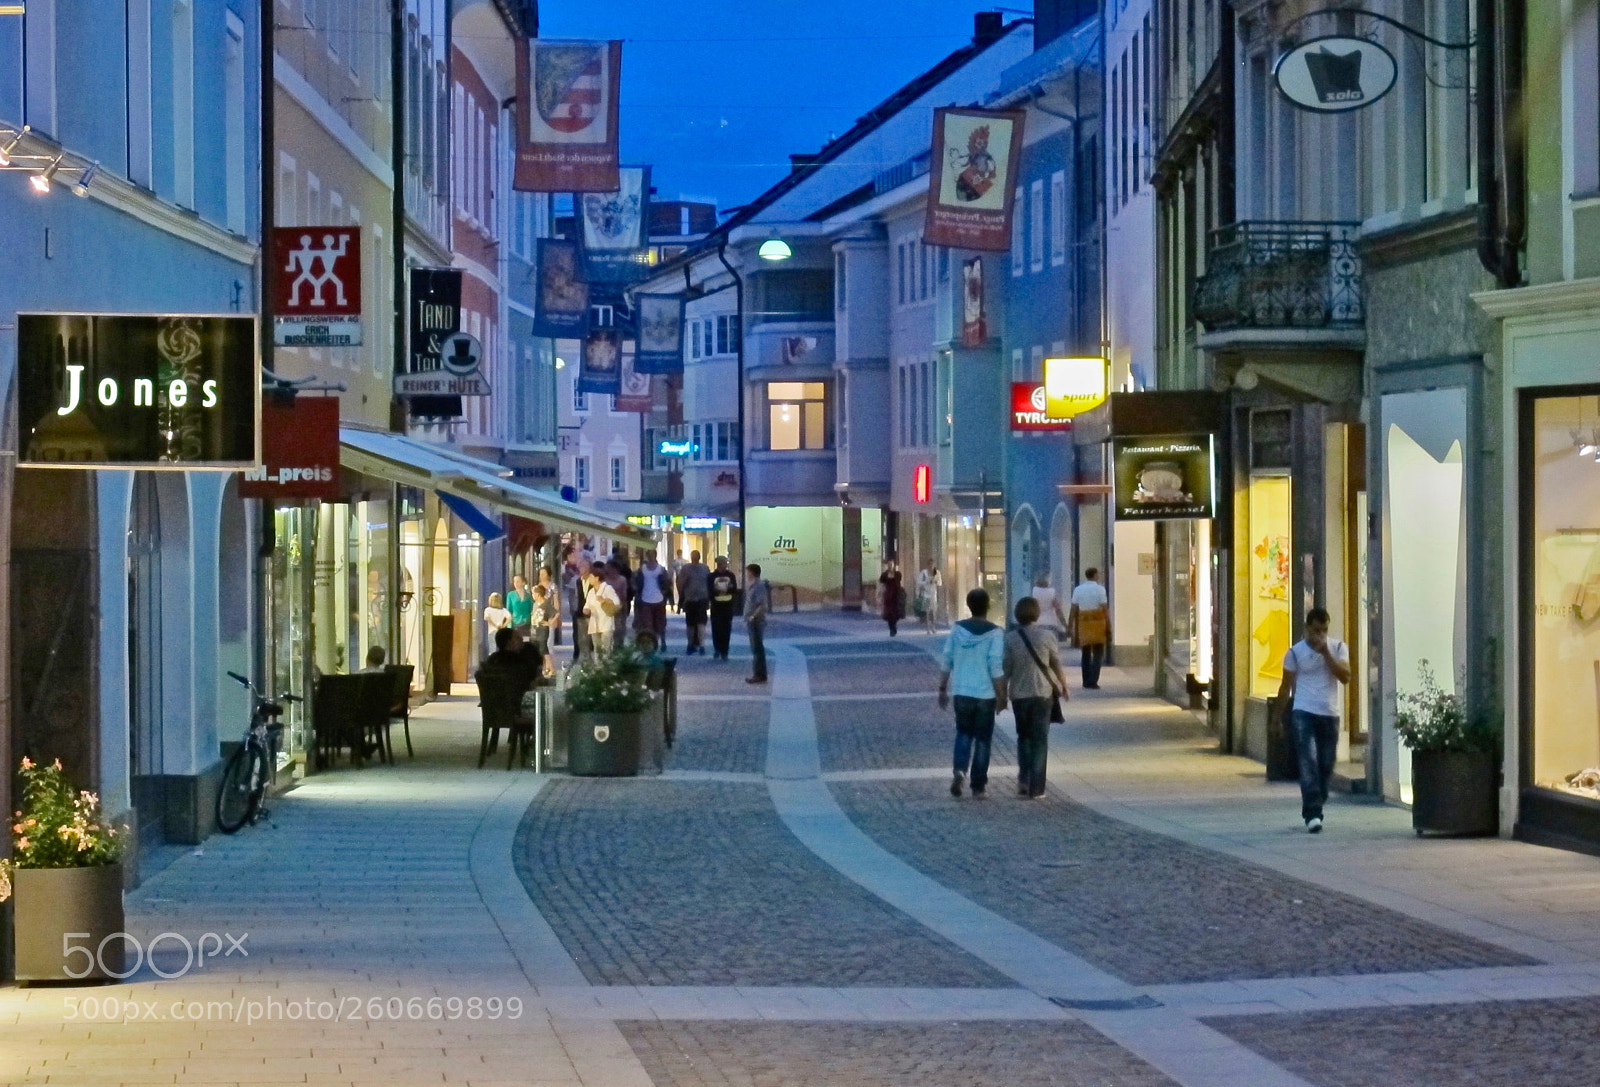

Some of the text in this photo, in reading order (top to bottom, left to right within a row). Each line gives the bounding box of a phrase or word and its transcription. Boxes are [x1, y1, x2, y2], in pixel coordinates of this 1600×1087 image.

[1325, 89, 1361, 101] solo
[305, 325, 329, 335] ERICH
[427, 334, 441, 354] &
[57, 364, 217, 416] Jones
[1062, 392, 1098, 403] sport
[774, 536, 796, 548] dm
